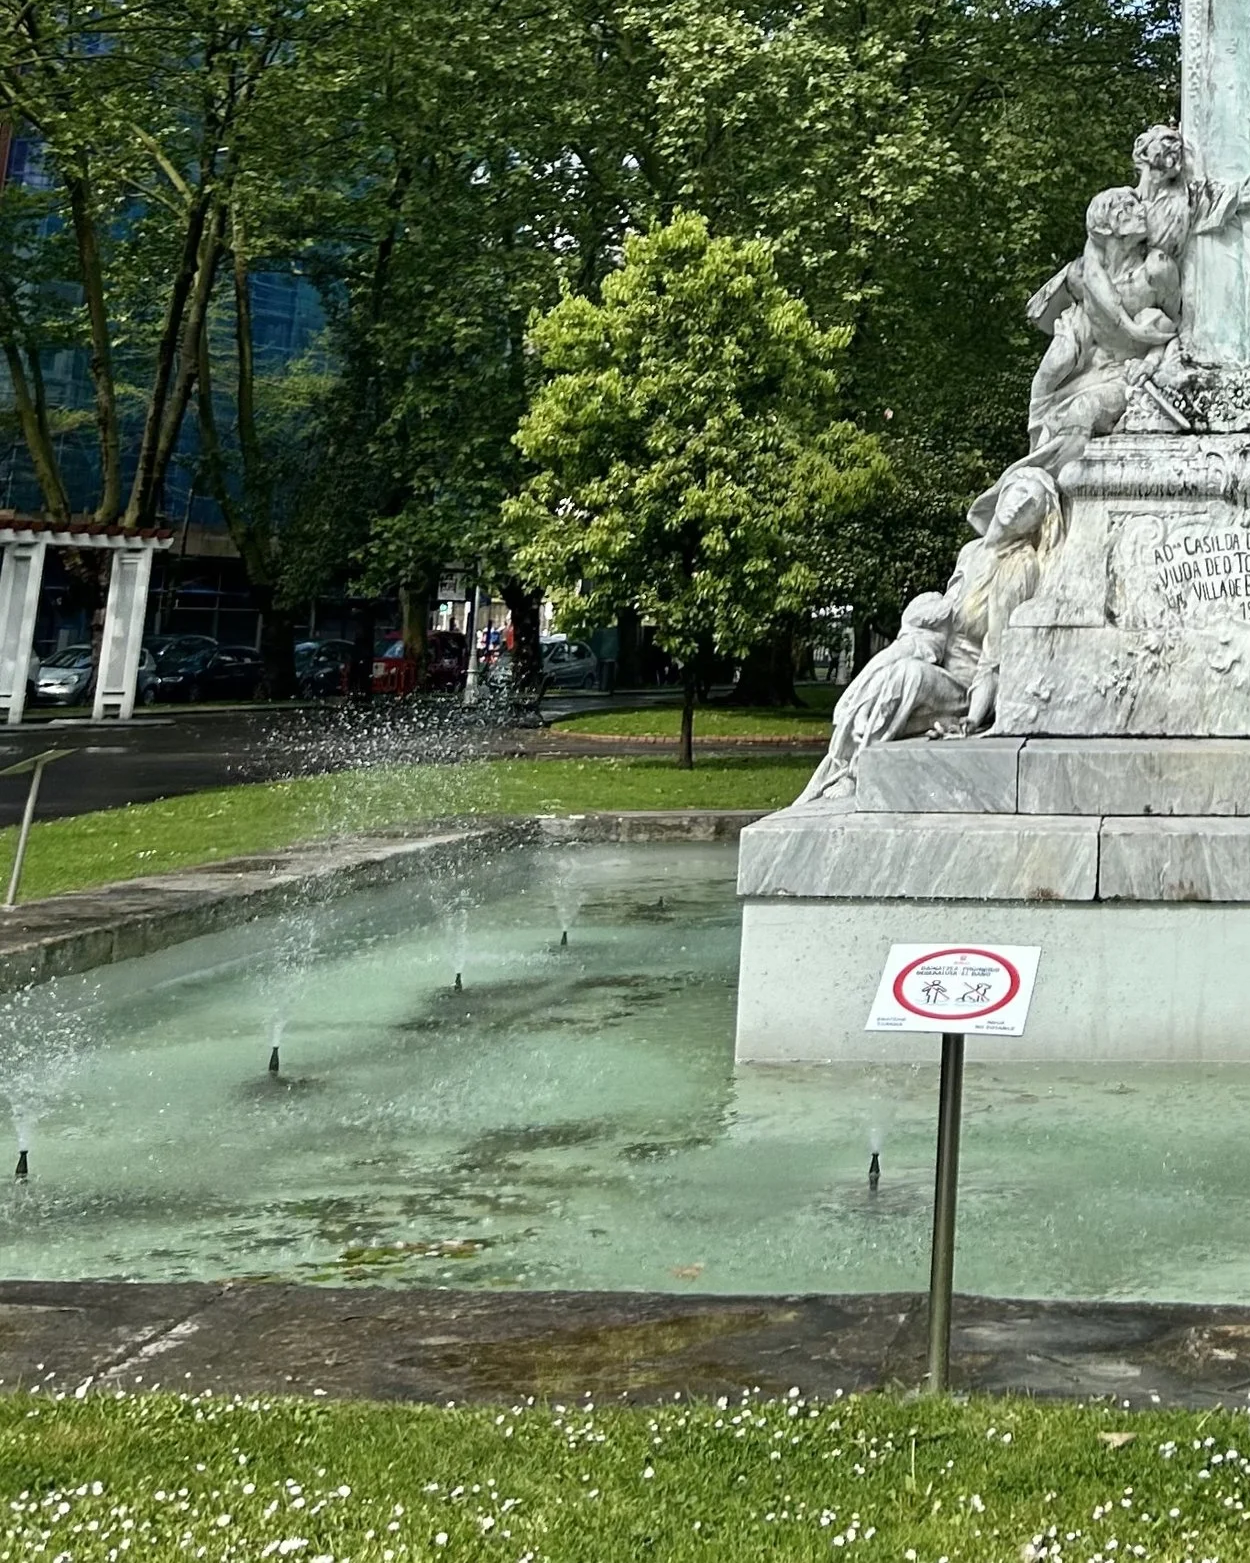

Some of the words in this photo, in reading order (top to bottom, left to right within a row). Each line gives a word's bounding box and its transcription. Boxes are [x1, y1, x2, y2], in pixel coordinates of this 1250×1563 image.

[1184, 533, 1240, 555] CASILDA
[1158, 560, 1201, 589] VIUDA
[1191, 579, 1228, 601] VILLA
[1228, 577, 1242, 597] DE
